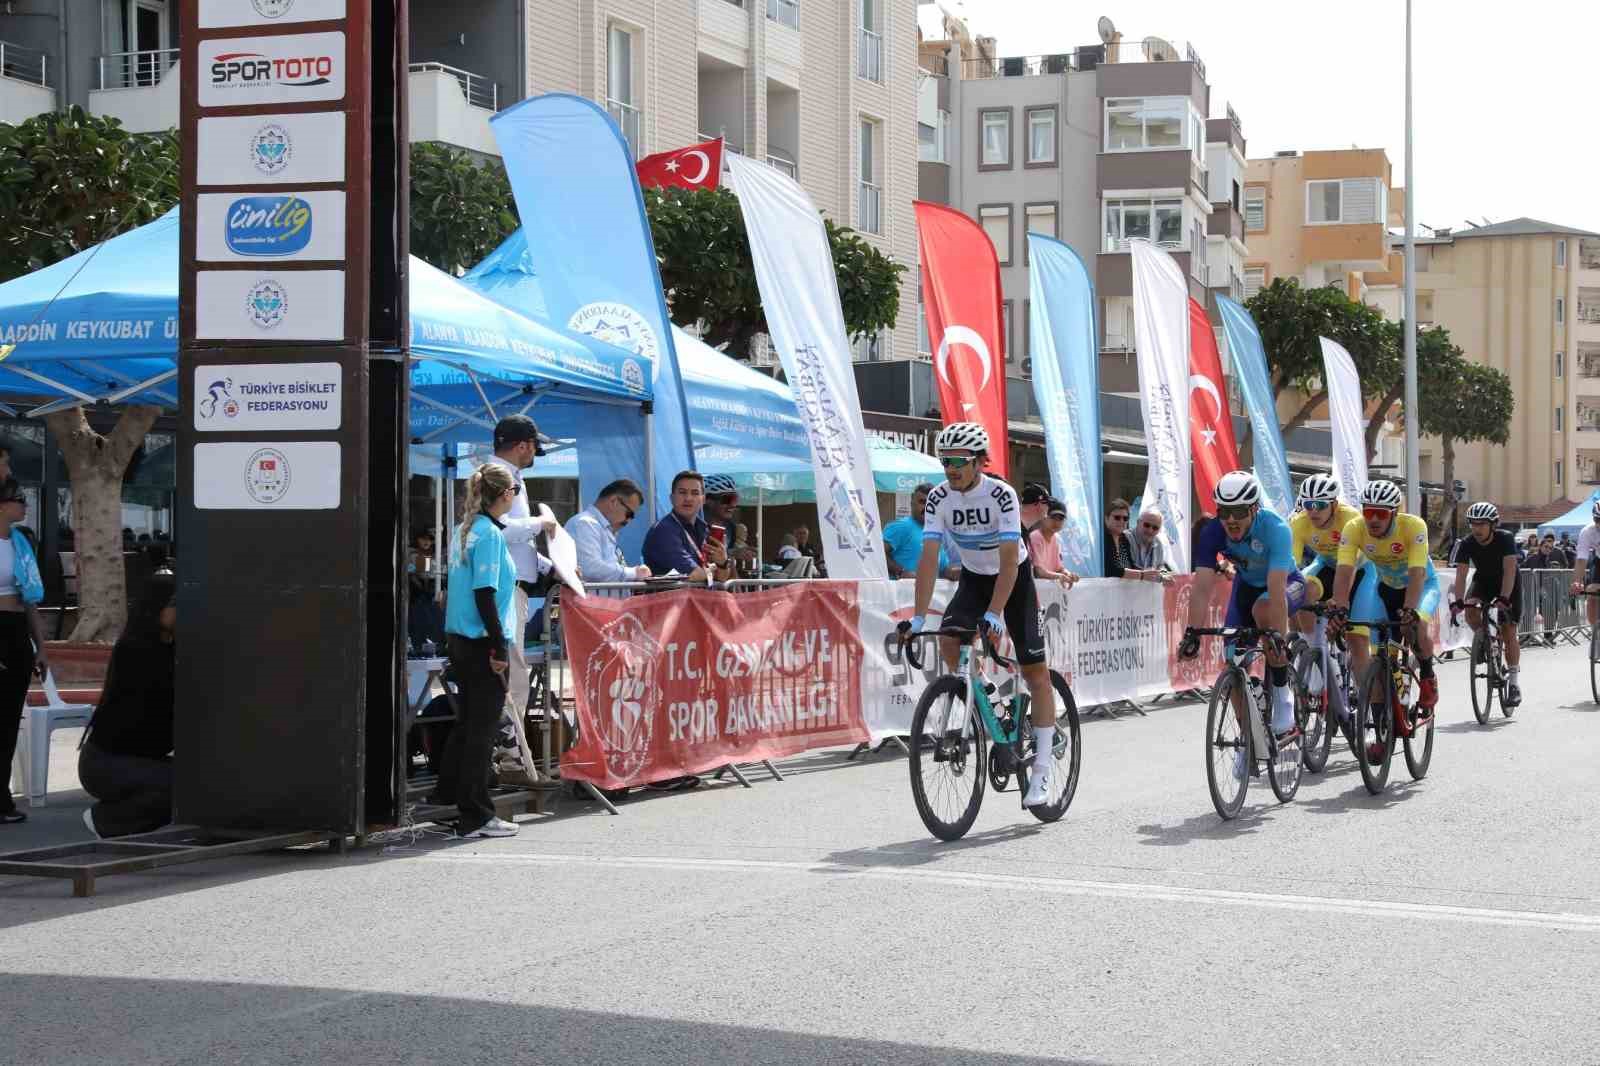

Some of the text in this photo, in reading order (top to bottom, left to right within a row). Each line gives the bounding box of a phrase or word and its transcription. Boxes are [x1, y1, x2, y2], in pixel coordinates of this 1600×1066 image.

[66, 320, 153, 339] KEYKUBAT
[240, 380, 337, 394] TÜRKİYE BİSİKLET
[247, 400, 328, 412] FEDERASYONU
[926, 486, 948, 515] DEU
[991, 486, 1014, 513] DEU
[952, 508, 990, 525] DEU
[1077, 612, 1115, 644] TÜRKİYE
[666, 641, 703, 680] T.C.
[804, 628, 832, 663] VE
[1078, 646, 1144, 677] FEDERASYONU
[668, 697, 719, 745] SPOR
